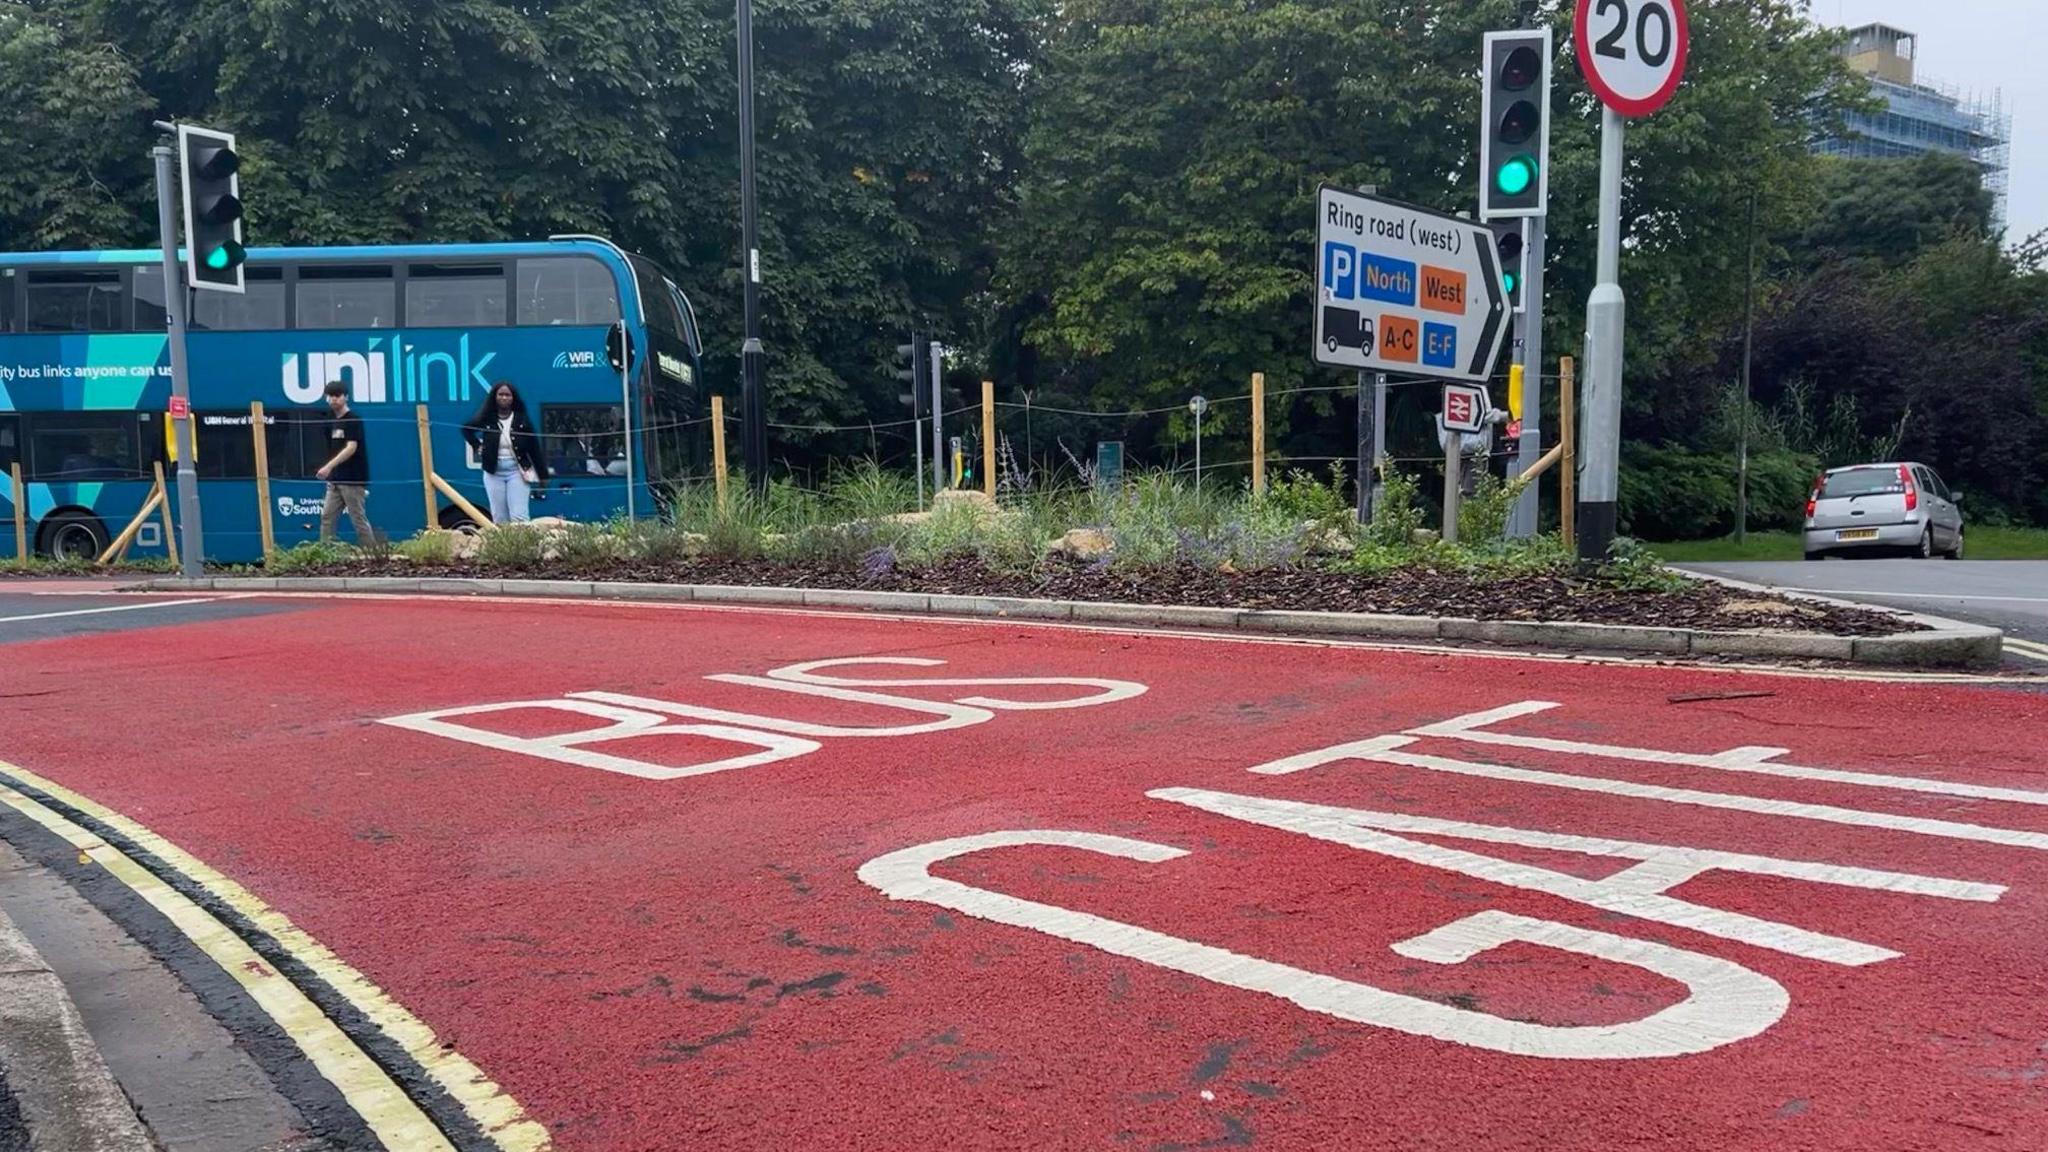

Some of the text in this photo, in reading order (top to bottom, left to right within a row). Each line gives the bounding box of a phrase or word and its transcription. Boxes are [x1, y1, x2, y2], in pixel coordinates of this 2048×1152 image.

[1595, 0, 1671, 67] 20
[1327, 201, 1462, 255] Ring road (west)
[1332, 249, 1463, 304] P North West
[1384, 328, 1452, 356] A-C E-F
[18, 365, 40, 378] bus
[43, 364, 71, 378] links
[74, 366, 127, 380] anyone
[130, 366, 155, 377] can
[158, 366, 173, 377] us
[375, 656, 1149, 780] BUS
